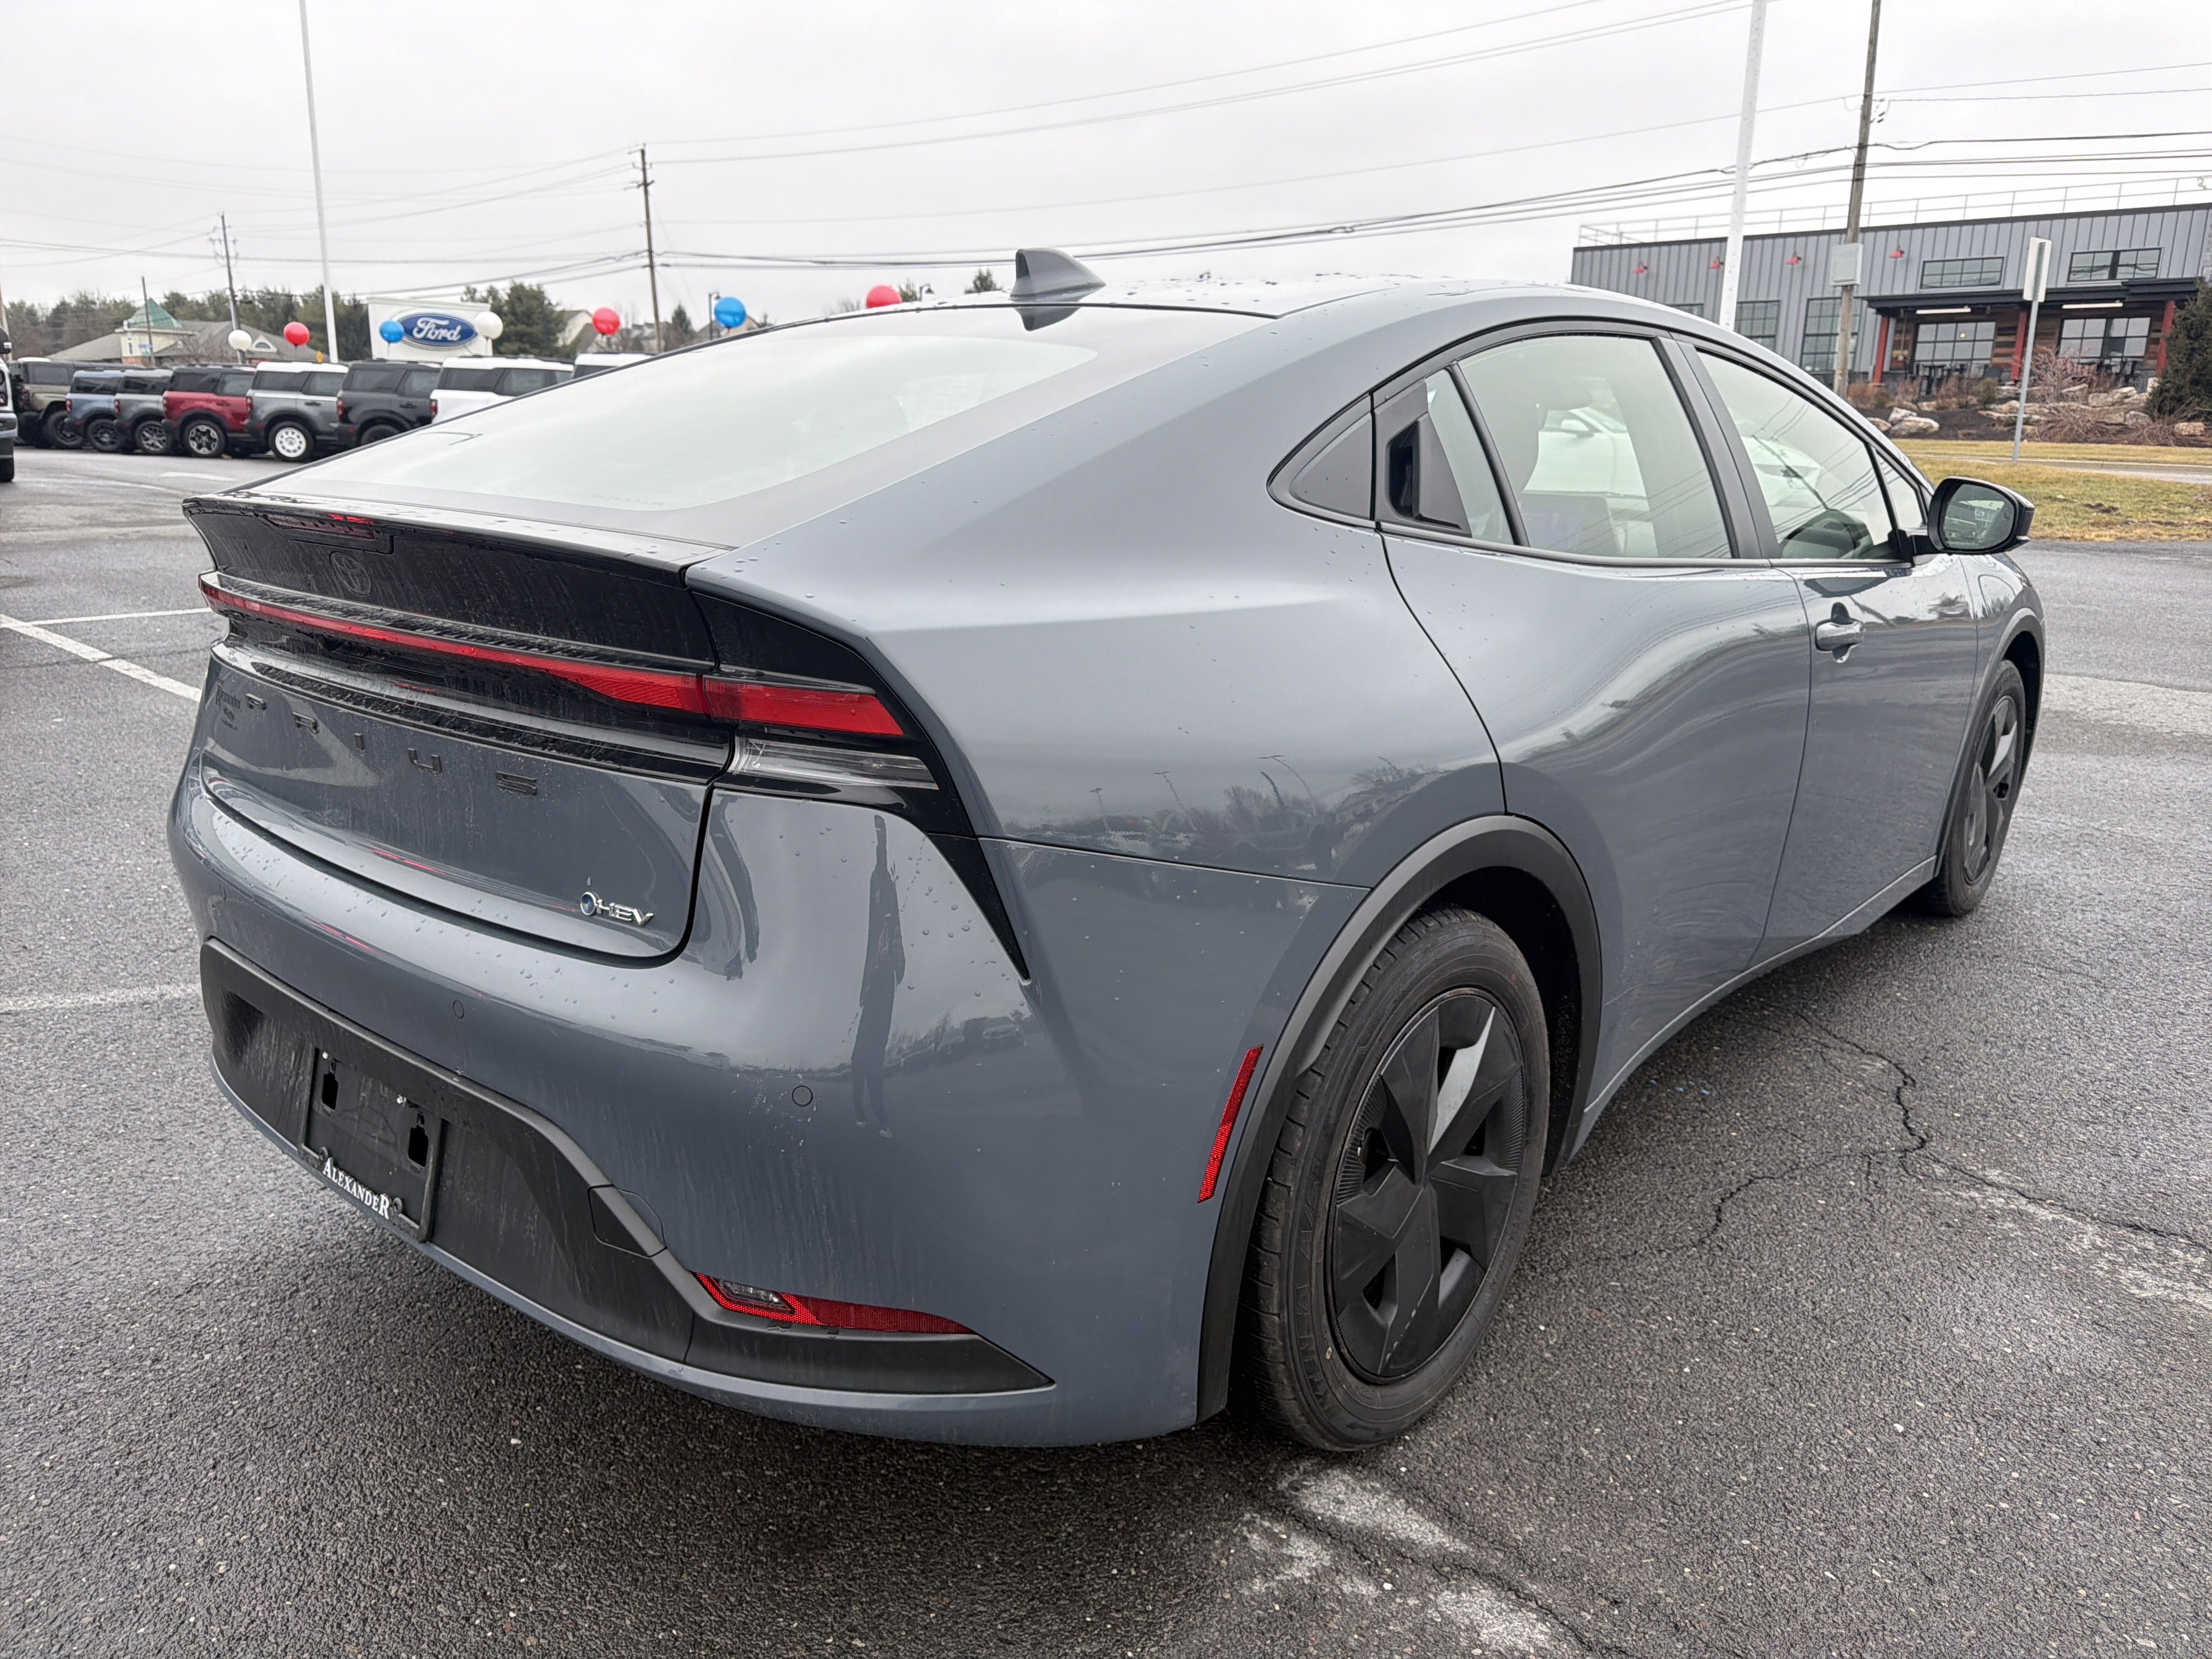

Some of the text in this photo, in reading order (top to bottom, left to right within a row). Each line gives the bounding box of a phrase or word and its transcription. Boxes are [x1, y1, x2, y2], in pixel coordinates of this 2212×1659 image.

[413, 317, 461, 341] Ford
[245, 693, 538, 796] PRIUS
[597, 899, 655, 926] HEV
[321, 1157, 390, 1220] ALEXANDER
